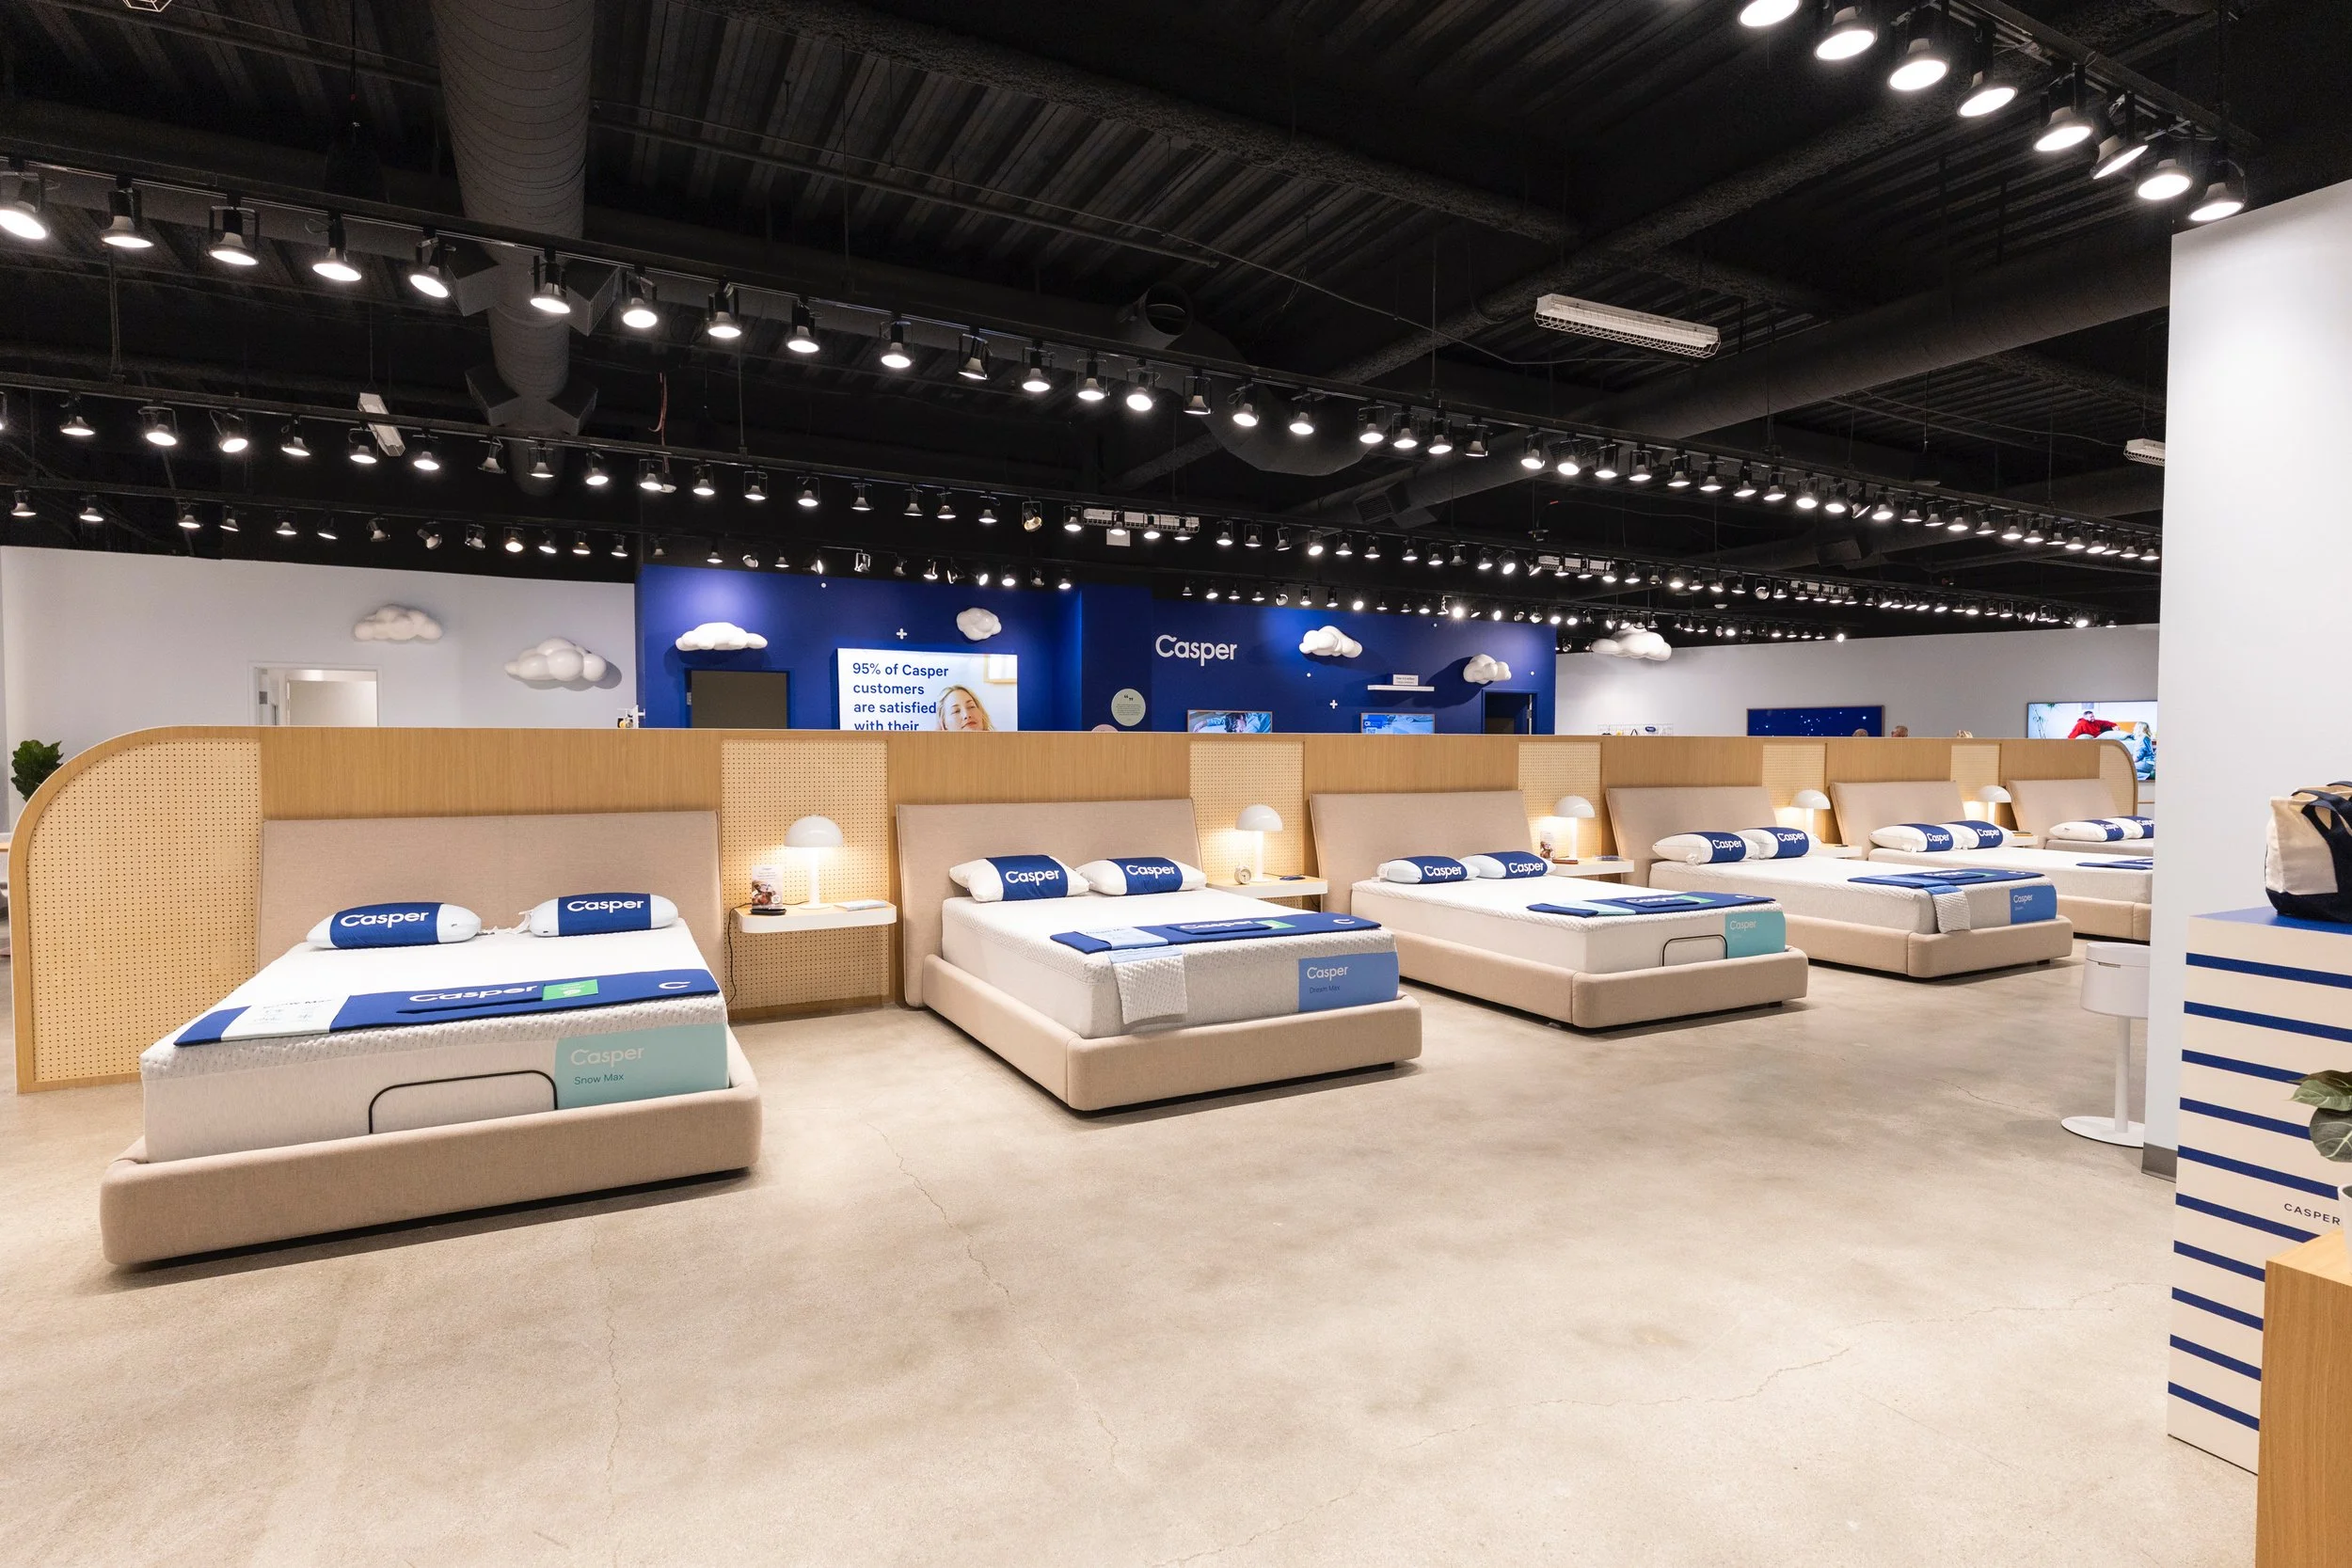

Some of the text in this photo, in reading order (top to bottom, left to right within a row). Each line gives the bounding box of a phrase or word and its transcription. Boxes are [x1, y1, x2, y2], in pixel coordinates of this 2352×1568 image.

[1155, 635, 1237, 667] Casper
[852, 662, 949, 678] 95% of Casper
[853, 683, 925, 695] customers
[853, 702, 937, 714] are satisfied
[854, 720, 919, 731] with their
[1777, 832, 1805, 844] Casper
[1927, 833, 1949, 845] Casper
[1977, 829, 2000, 839] Casper
[1712, 839, 1742, 851] Casper
[1126, 864, 1175, 879] Casper
[1424, 865, 1462, 879] Casper
[1509, 863, 1544, 875] Casper
[1005, 869, 1060, 886] Casper
[566, 897, 644, 913] Casper
[340, 910, 429, 928] Casper
[1729, 920, 1756, 931] Casper
[1307, 966, 1349, 981] Casper
[408, 984, 538, 1002] Casper
[570, 1046, 645, 1068] Casper
[574, 1073, 624, 1085] Snow Max
[2283, 1203, 2341, 1226] CASPER
